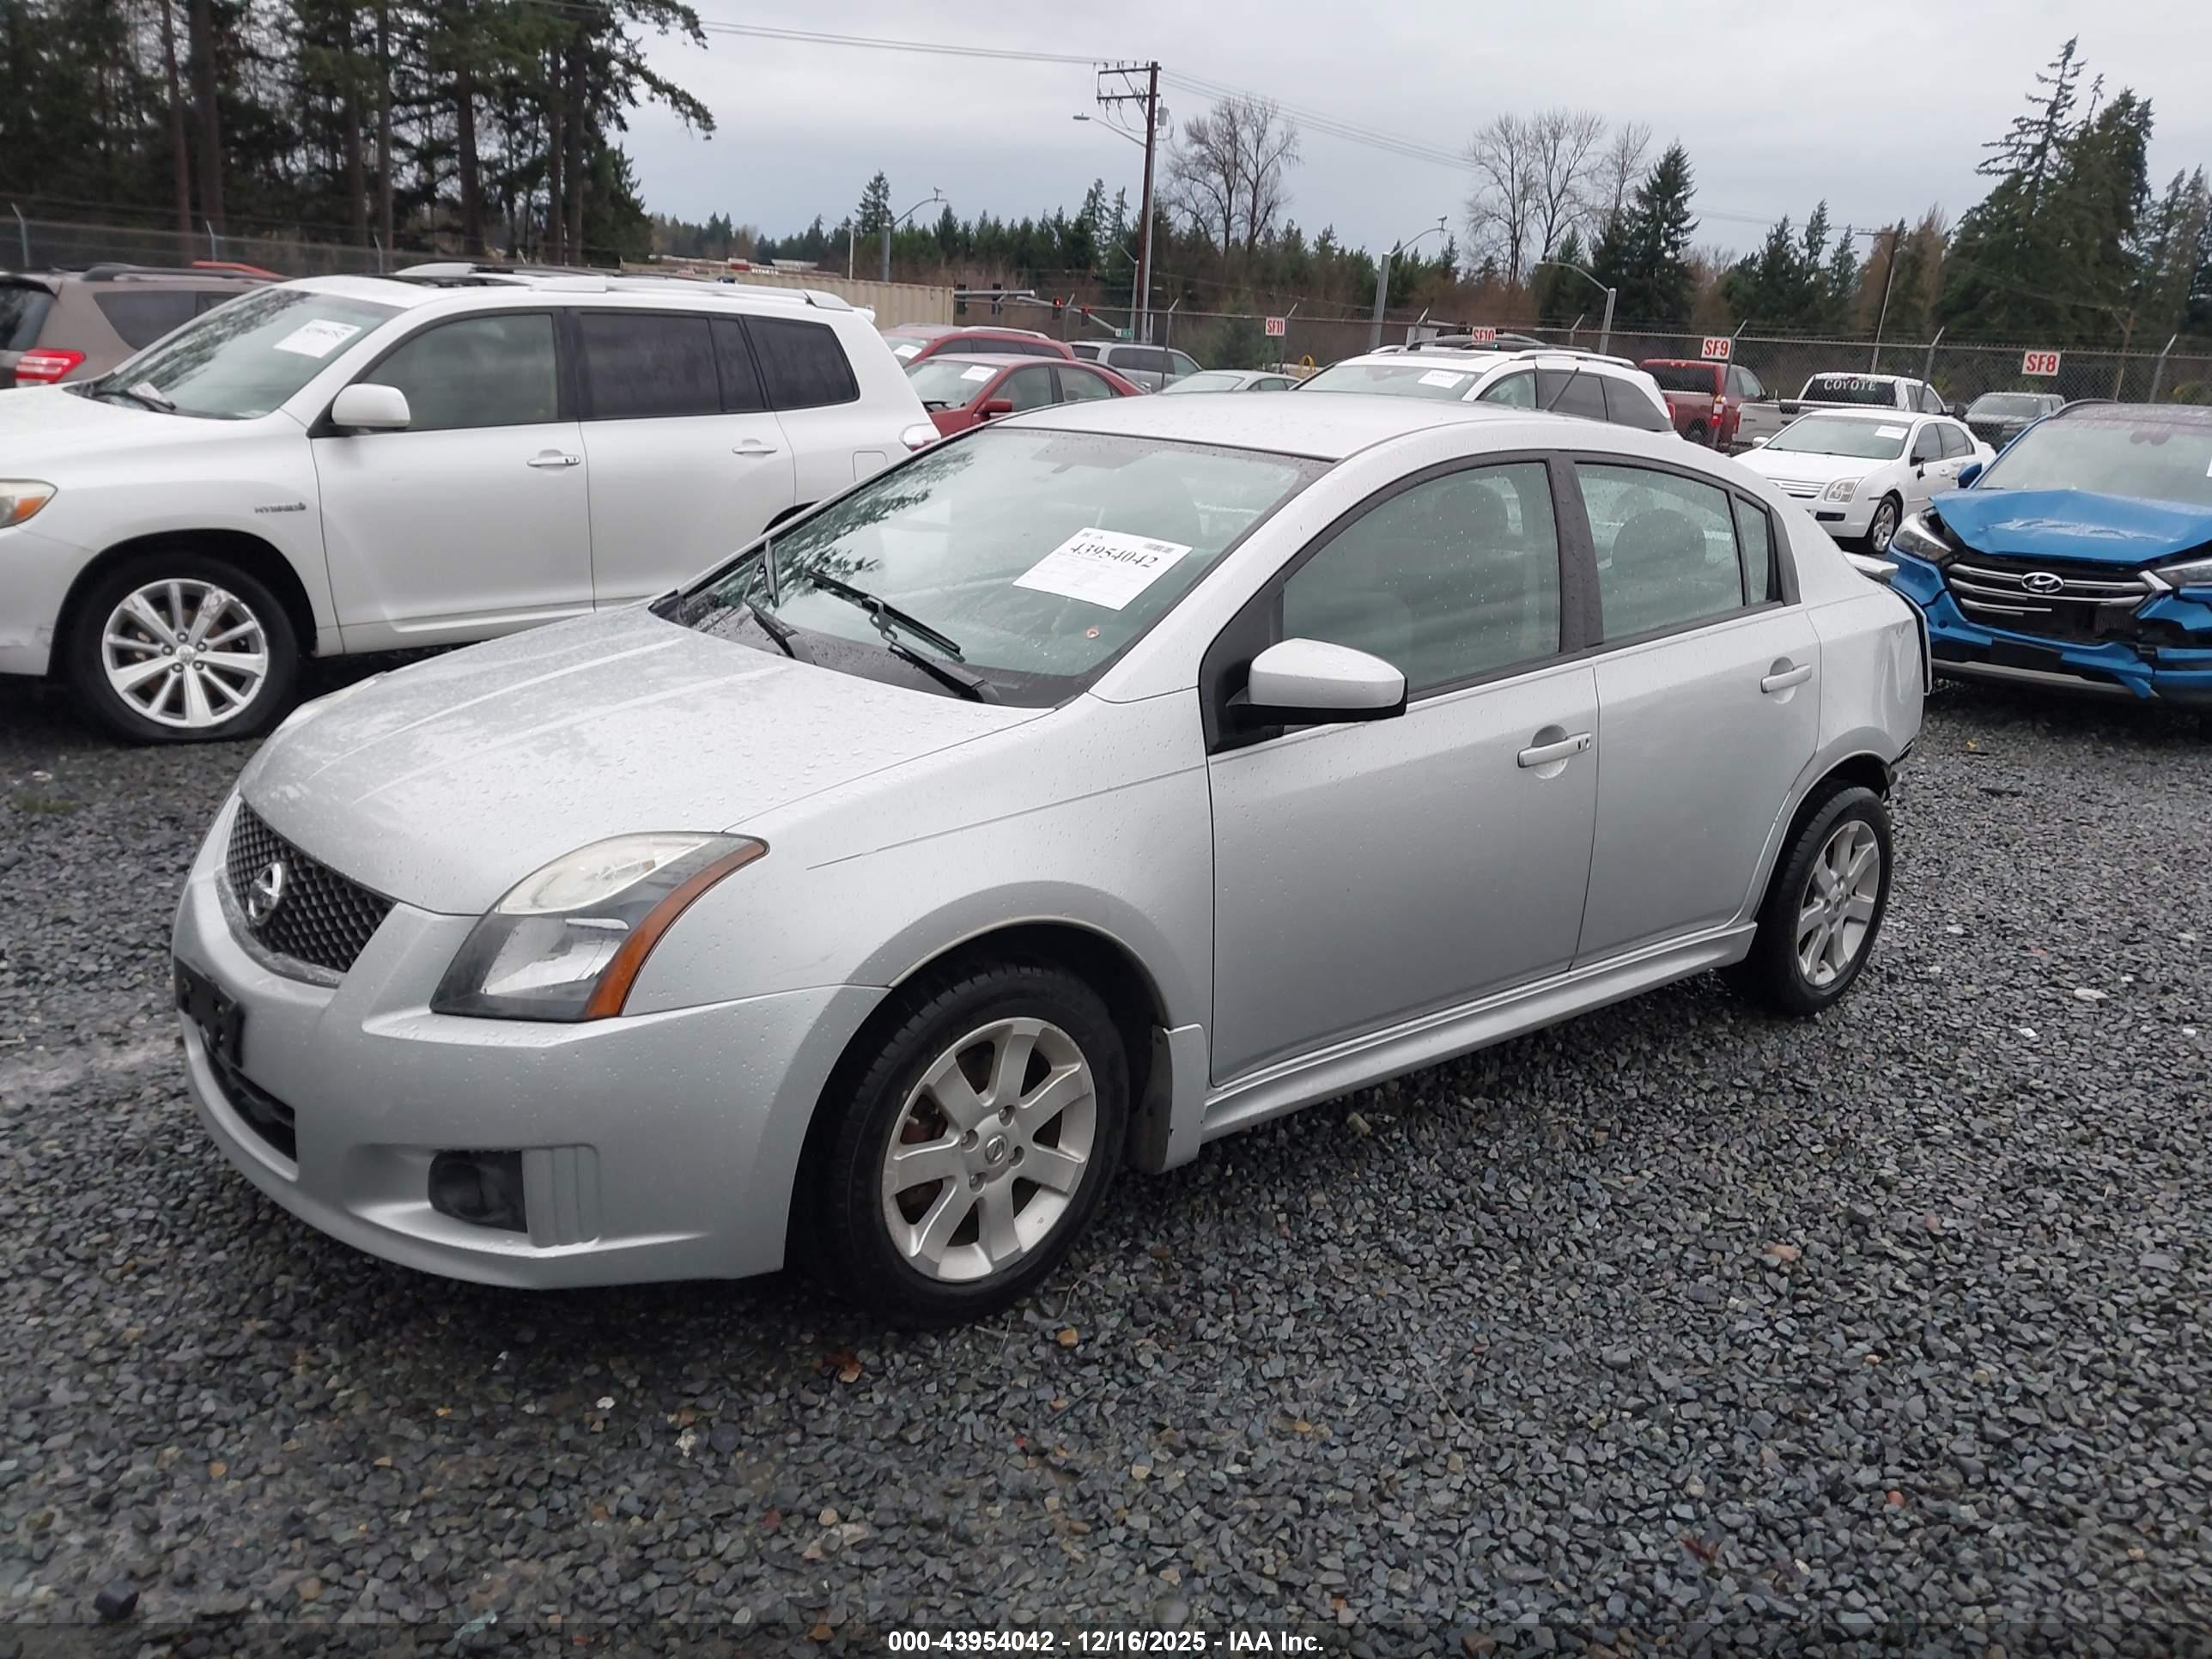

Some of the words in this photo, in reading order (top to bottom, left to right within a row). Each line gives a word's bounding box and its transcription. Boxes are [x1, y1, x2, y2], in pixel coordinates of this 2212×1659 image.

[1267, 319, 1283, 334] SF11
[1705, 339, 1729, 356] SF9
[2027, 354, 2057, 372] SF8
[1824, 379, 1877, 391] COYOTE
[1070, 543, 1158, 568] 43954042
